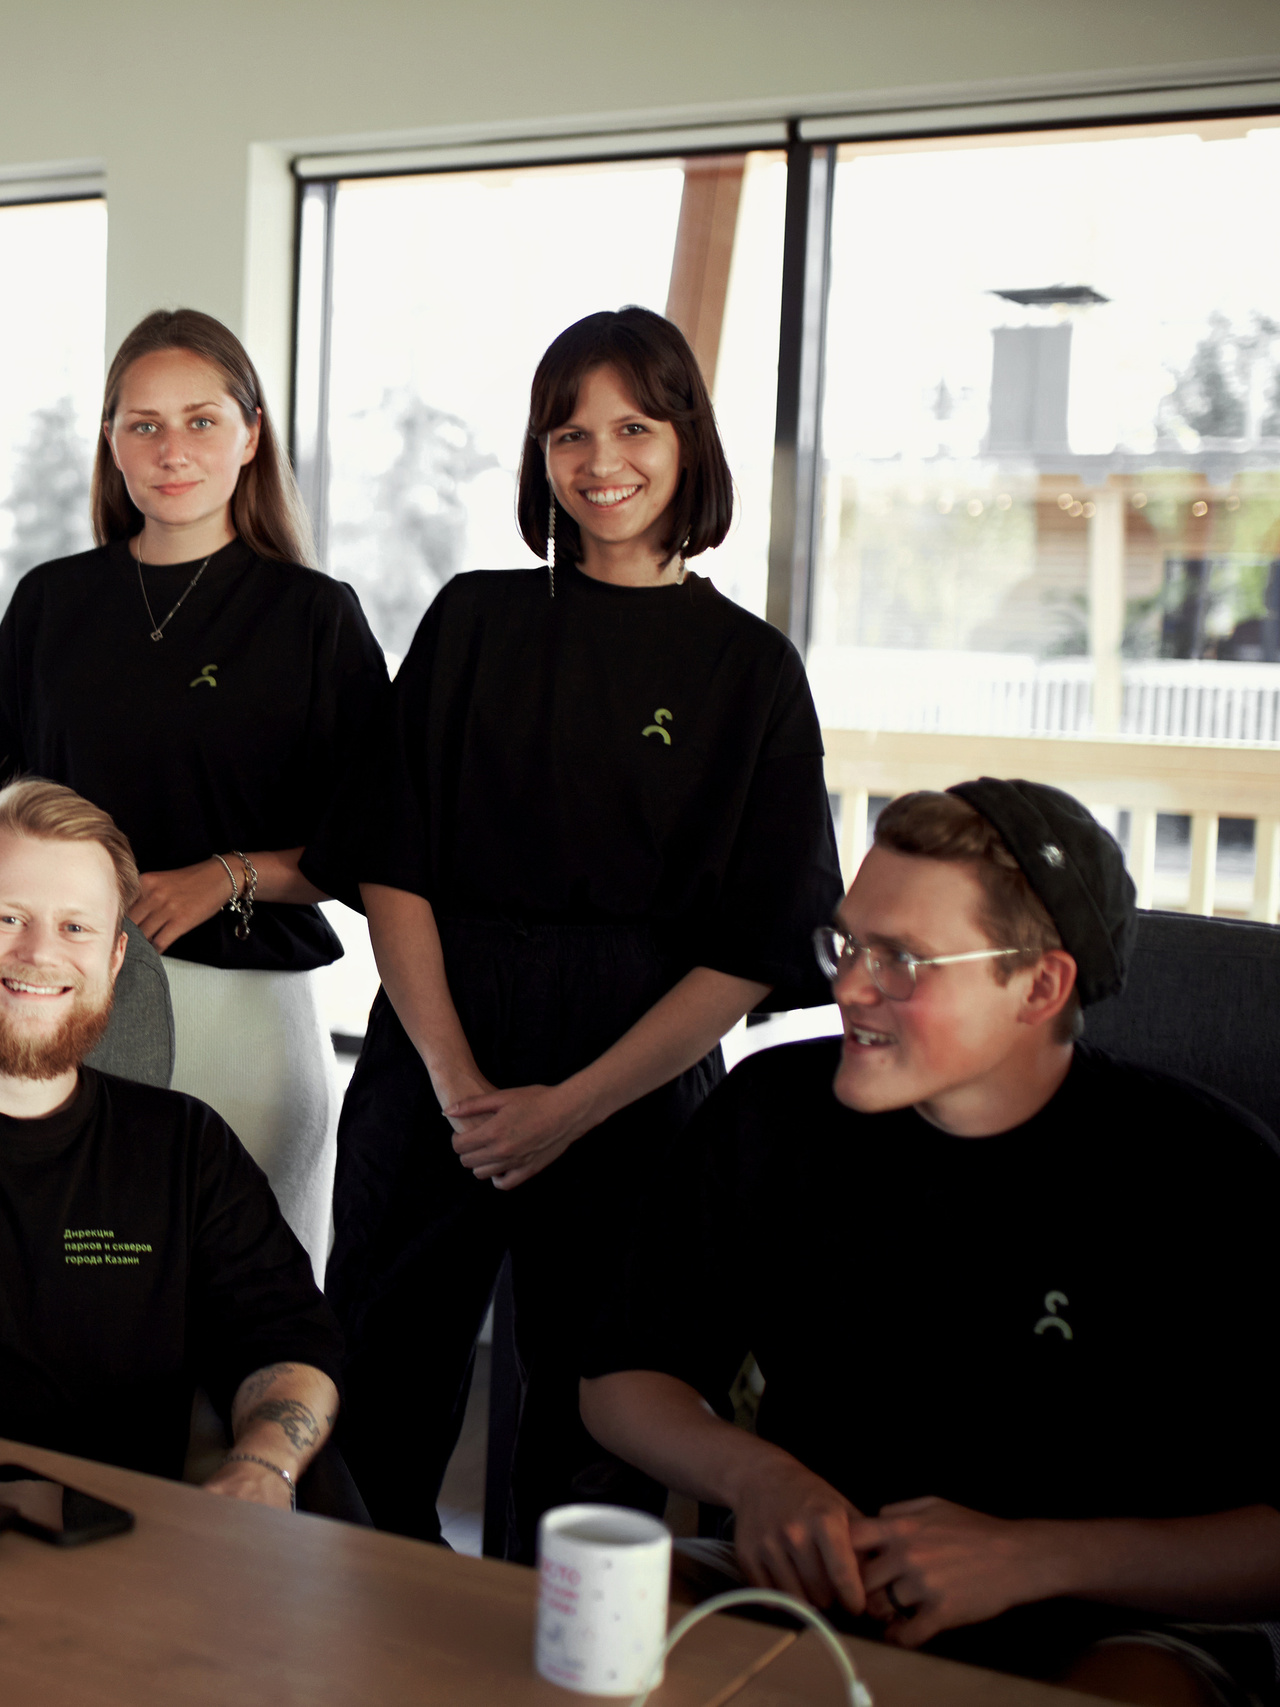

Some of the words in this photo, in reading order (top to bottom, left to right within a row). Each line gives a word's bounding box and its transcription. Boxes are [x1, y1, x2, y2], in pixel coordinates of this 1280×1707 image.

[63, 1228, 115, 1239] Дирекция
[64, 1242, 103, 1253] парков
[104, 1242, 111, 1251] и
[112, 1242, 153, 1253] скверов
[65, 1255, 103, 1266] города
[104, 1253, 140, 1265] Казани
